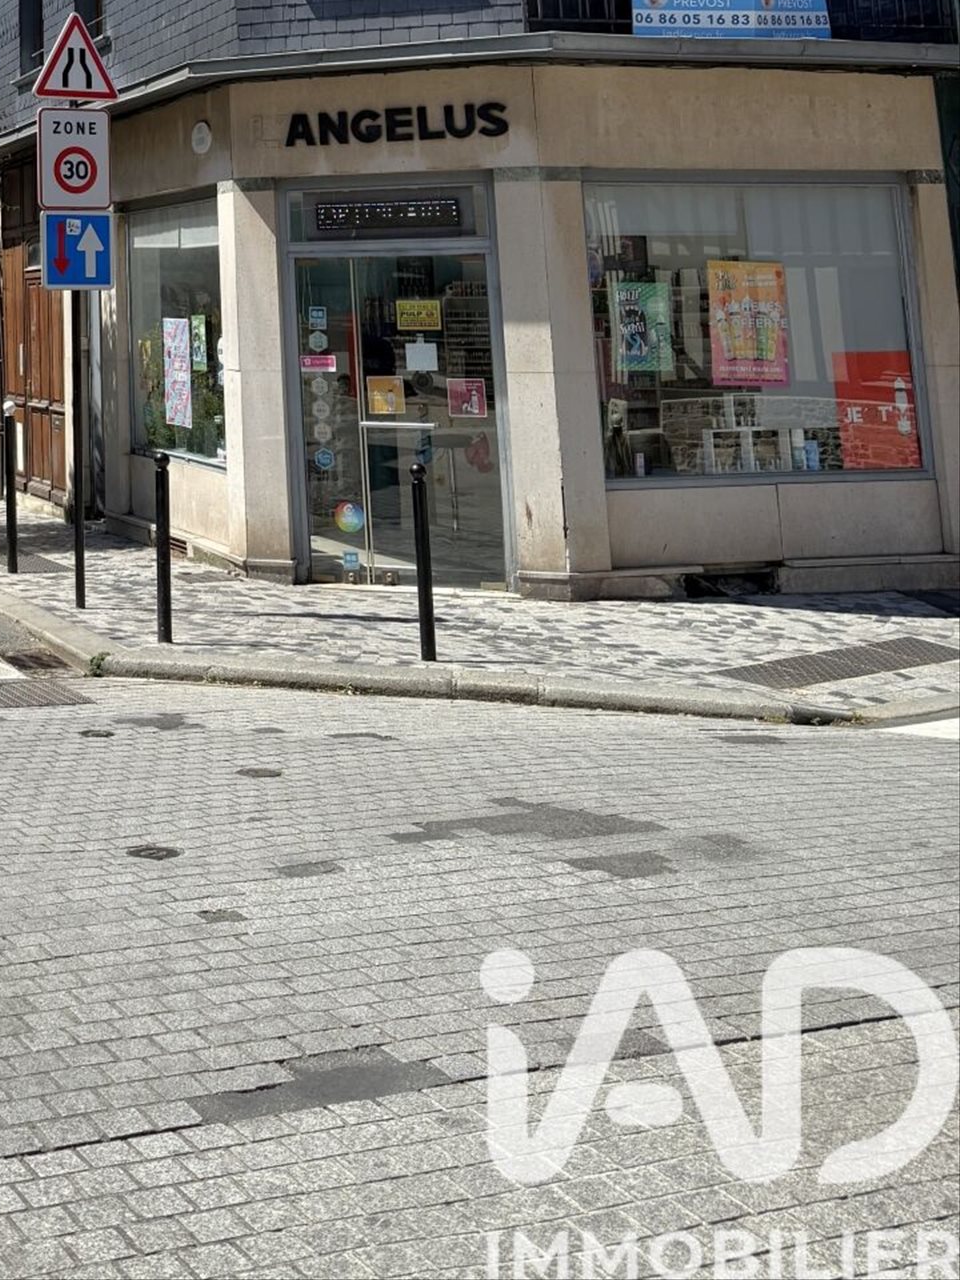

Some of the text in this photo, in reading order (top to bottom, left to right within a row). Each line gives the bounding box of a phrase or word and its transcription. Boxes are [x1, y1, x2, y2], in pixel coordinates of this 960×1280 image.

[634, 12, 750, 26] 06 86 05 16 83
[757, 14, 828, 26] 06 86 05 16 83
[52, 120, 98, 135] ZONE
[285, 102, 510, 147] ANGELUS
[62, 160, 89, 180] 30
